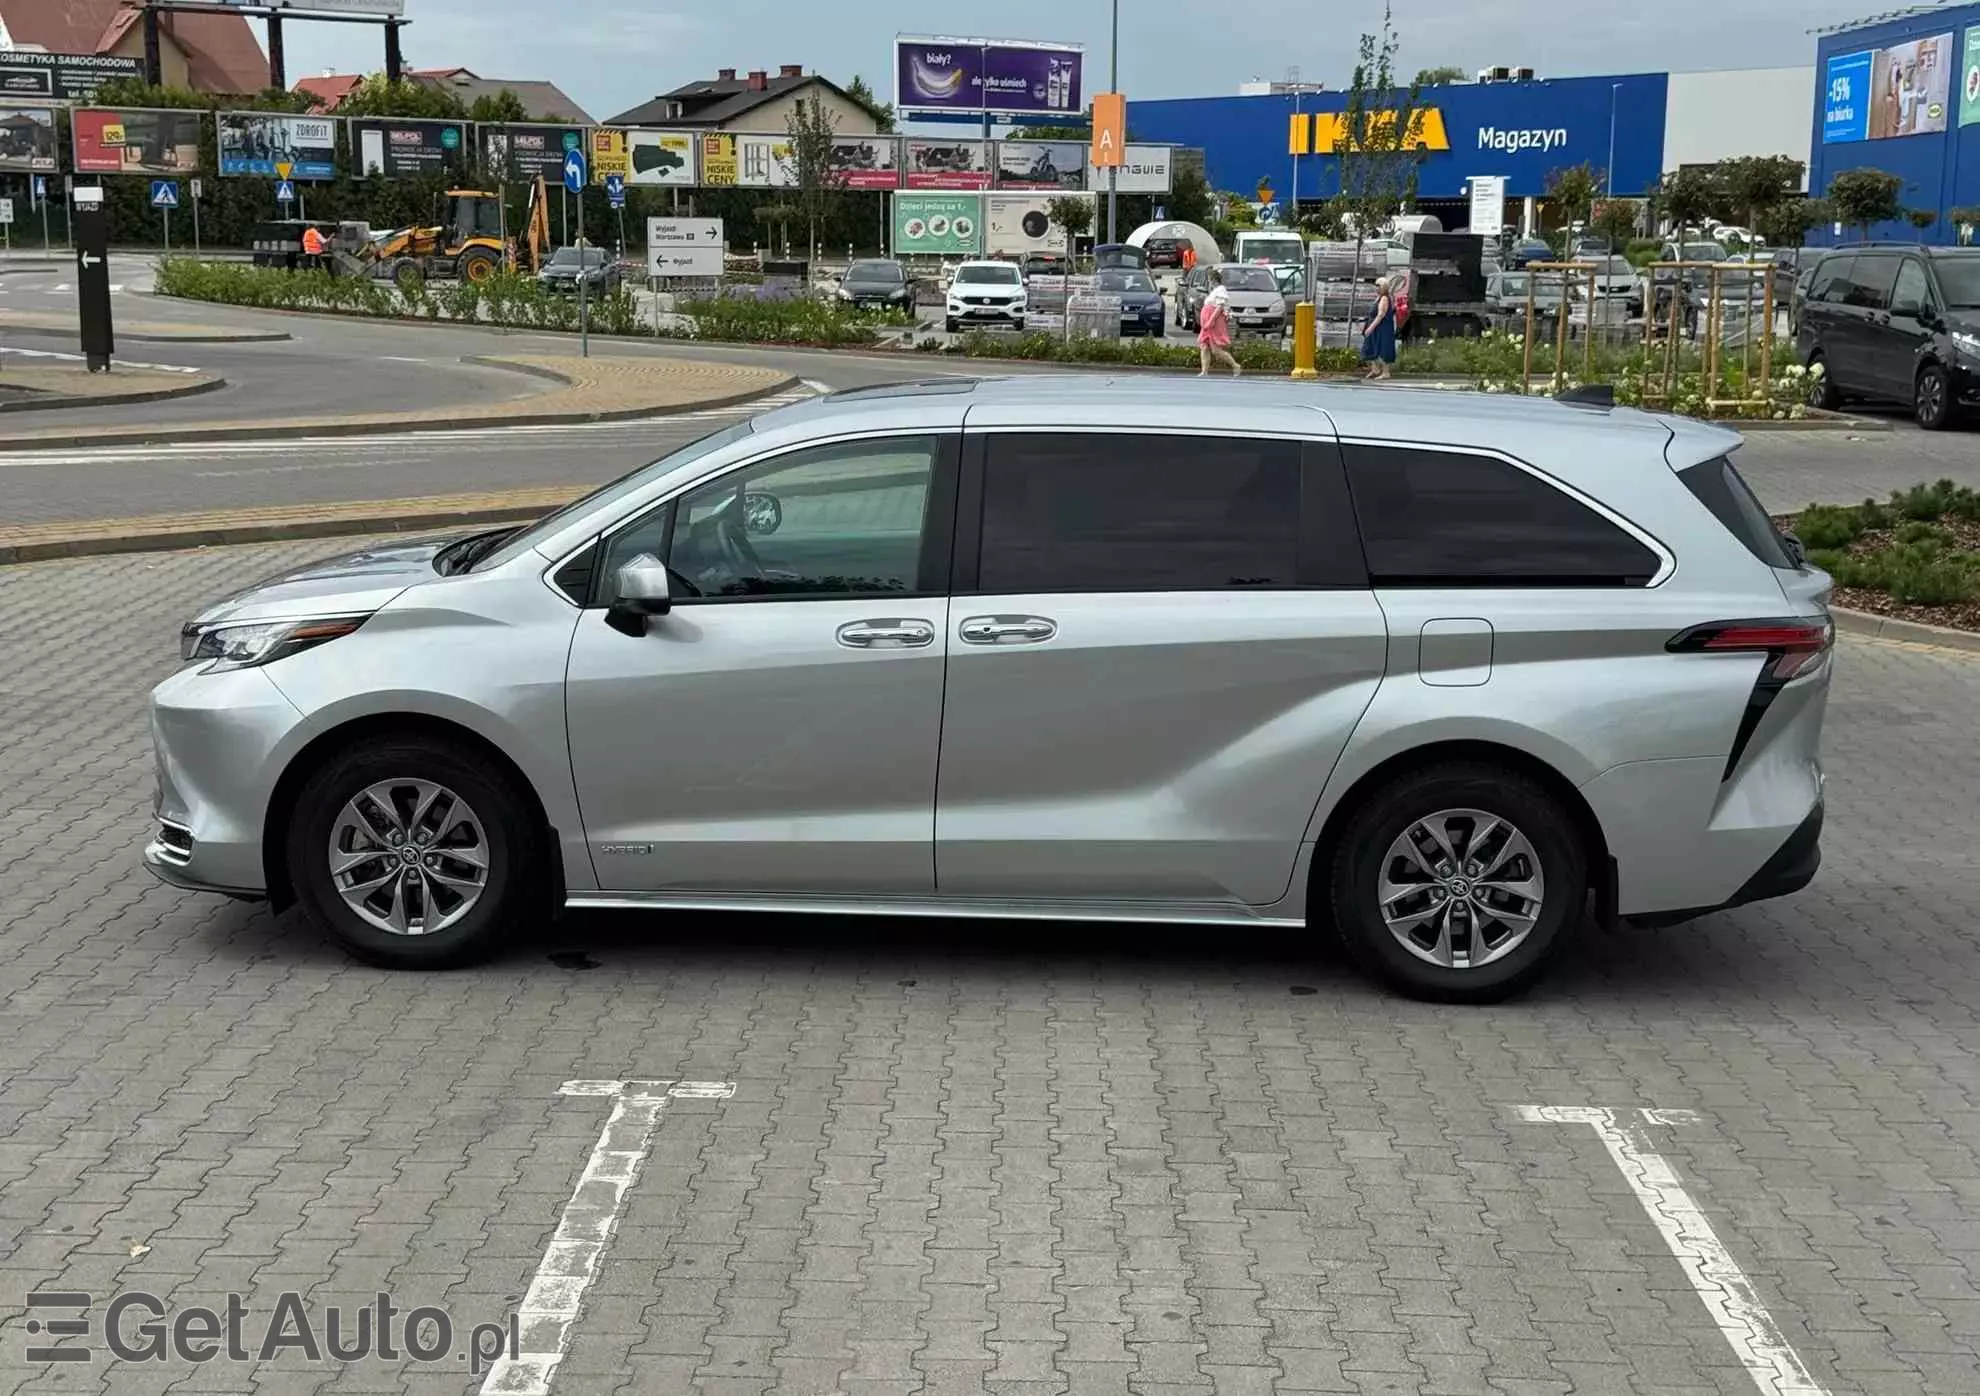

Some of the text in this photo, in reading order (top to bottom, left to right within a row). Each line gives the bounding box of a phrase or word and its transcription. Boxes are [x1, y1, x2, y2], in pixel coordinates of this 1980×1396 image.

[0, 53, 136, 68] OSMETYKA SAMOCHODOWA
[1829, 77, 1850, 102] -15%
[1100, 129, 1112, 149] A
[1289, 107, 1450, 155] IKEA
[1478, 126, 1567, 153] Magazyn
[597, 162, 626, 171] NISKIE
[706, 165, 734, 174] NISKIE
[707, 175, 735, 185] CENY
